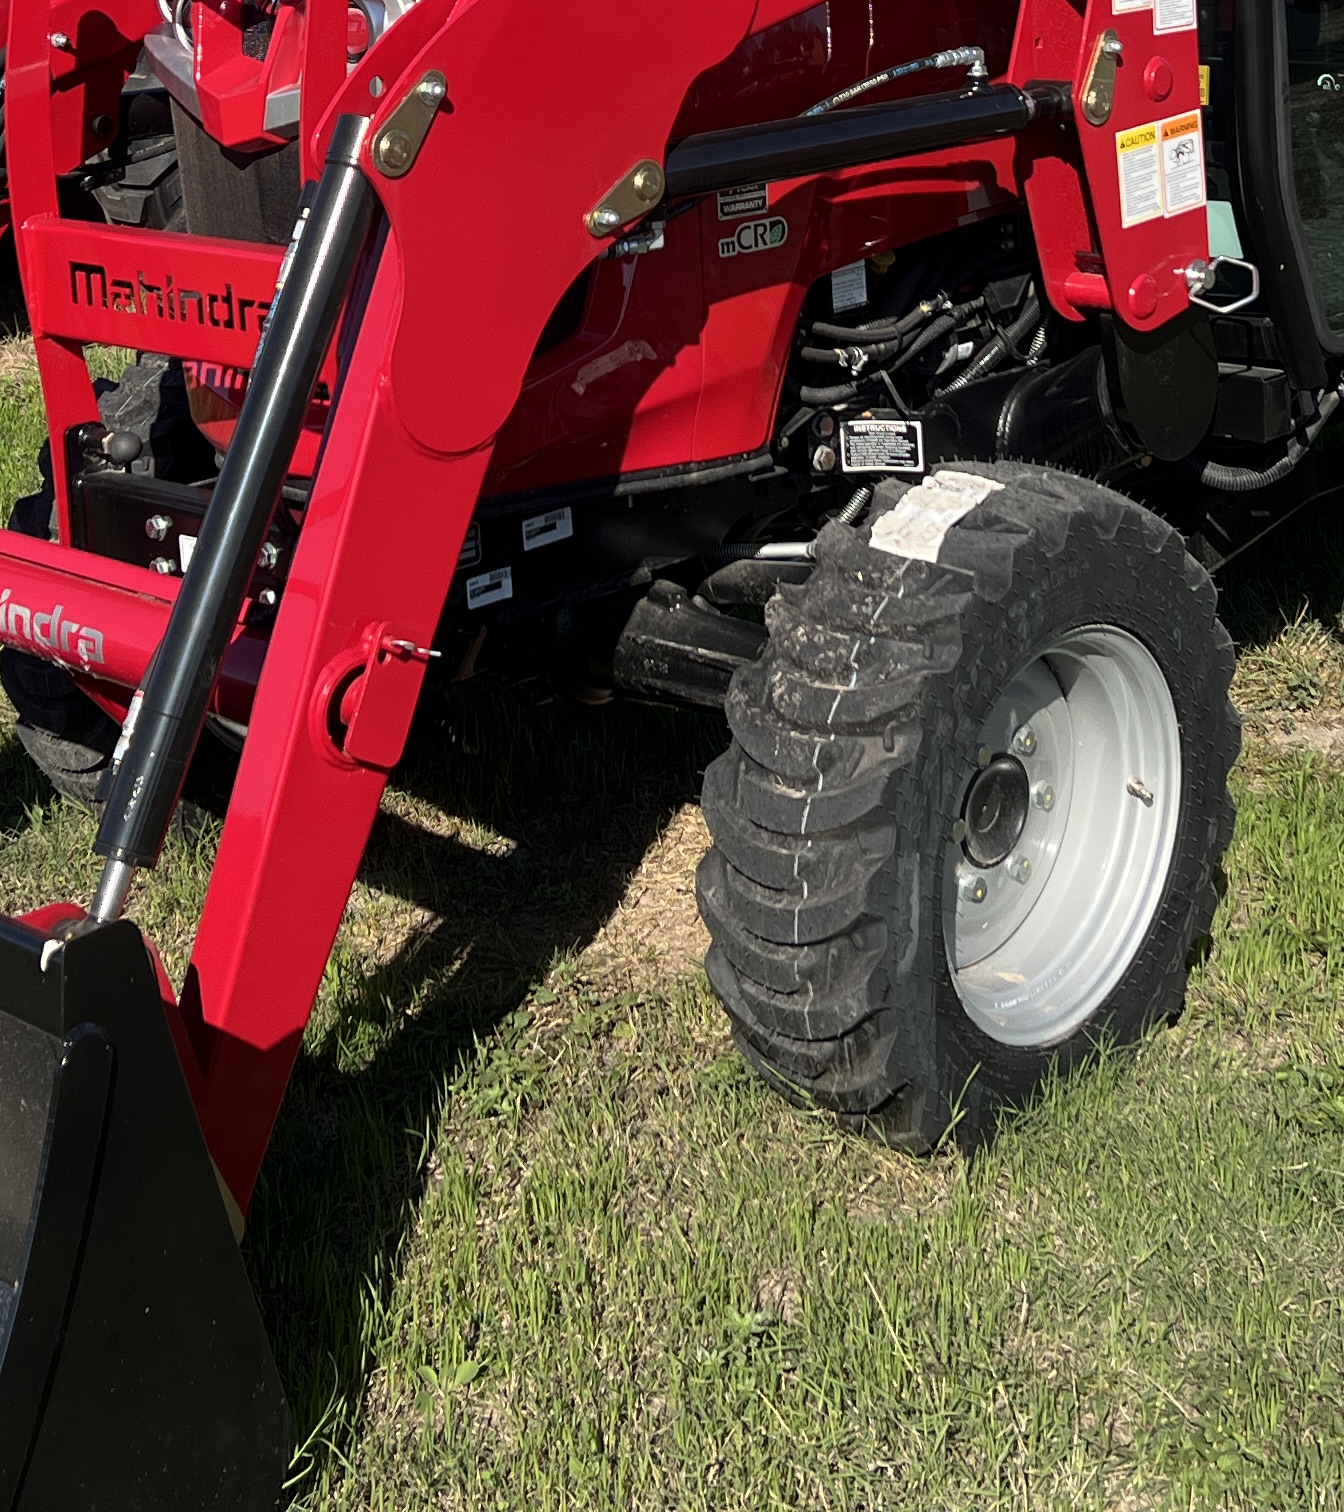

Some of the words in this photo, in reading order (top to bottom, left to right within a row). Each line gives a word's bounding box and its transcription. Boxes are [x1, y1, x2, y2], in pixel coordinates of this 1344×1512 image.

[1170, 120, 1199, 134] WARNING
[1125, 131, 1156, 147] CAUTION
[723, 198, 764, 213] WARRANTY
[853, 424, 907, 434] INSTRUCTIONS
